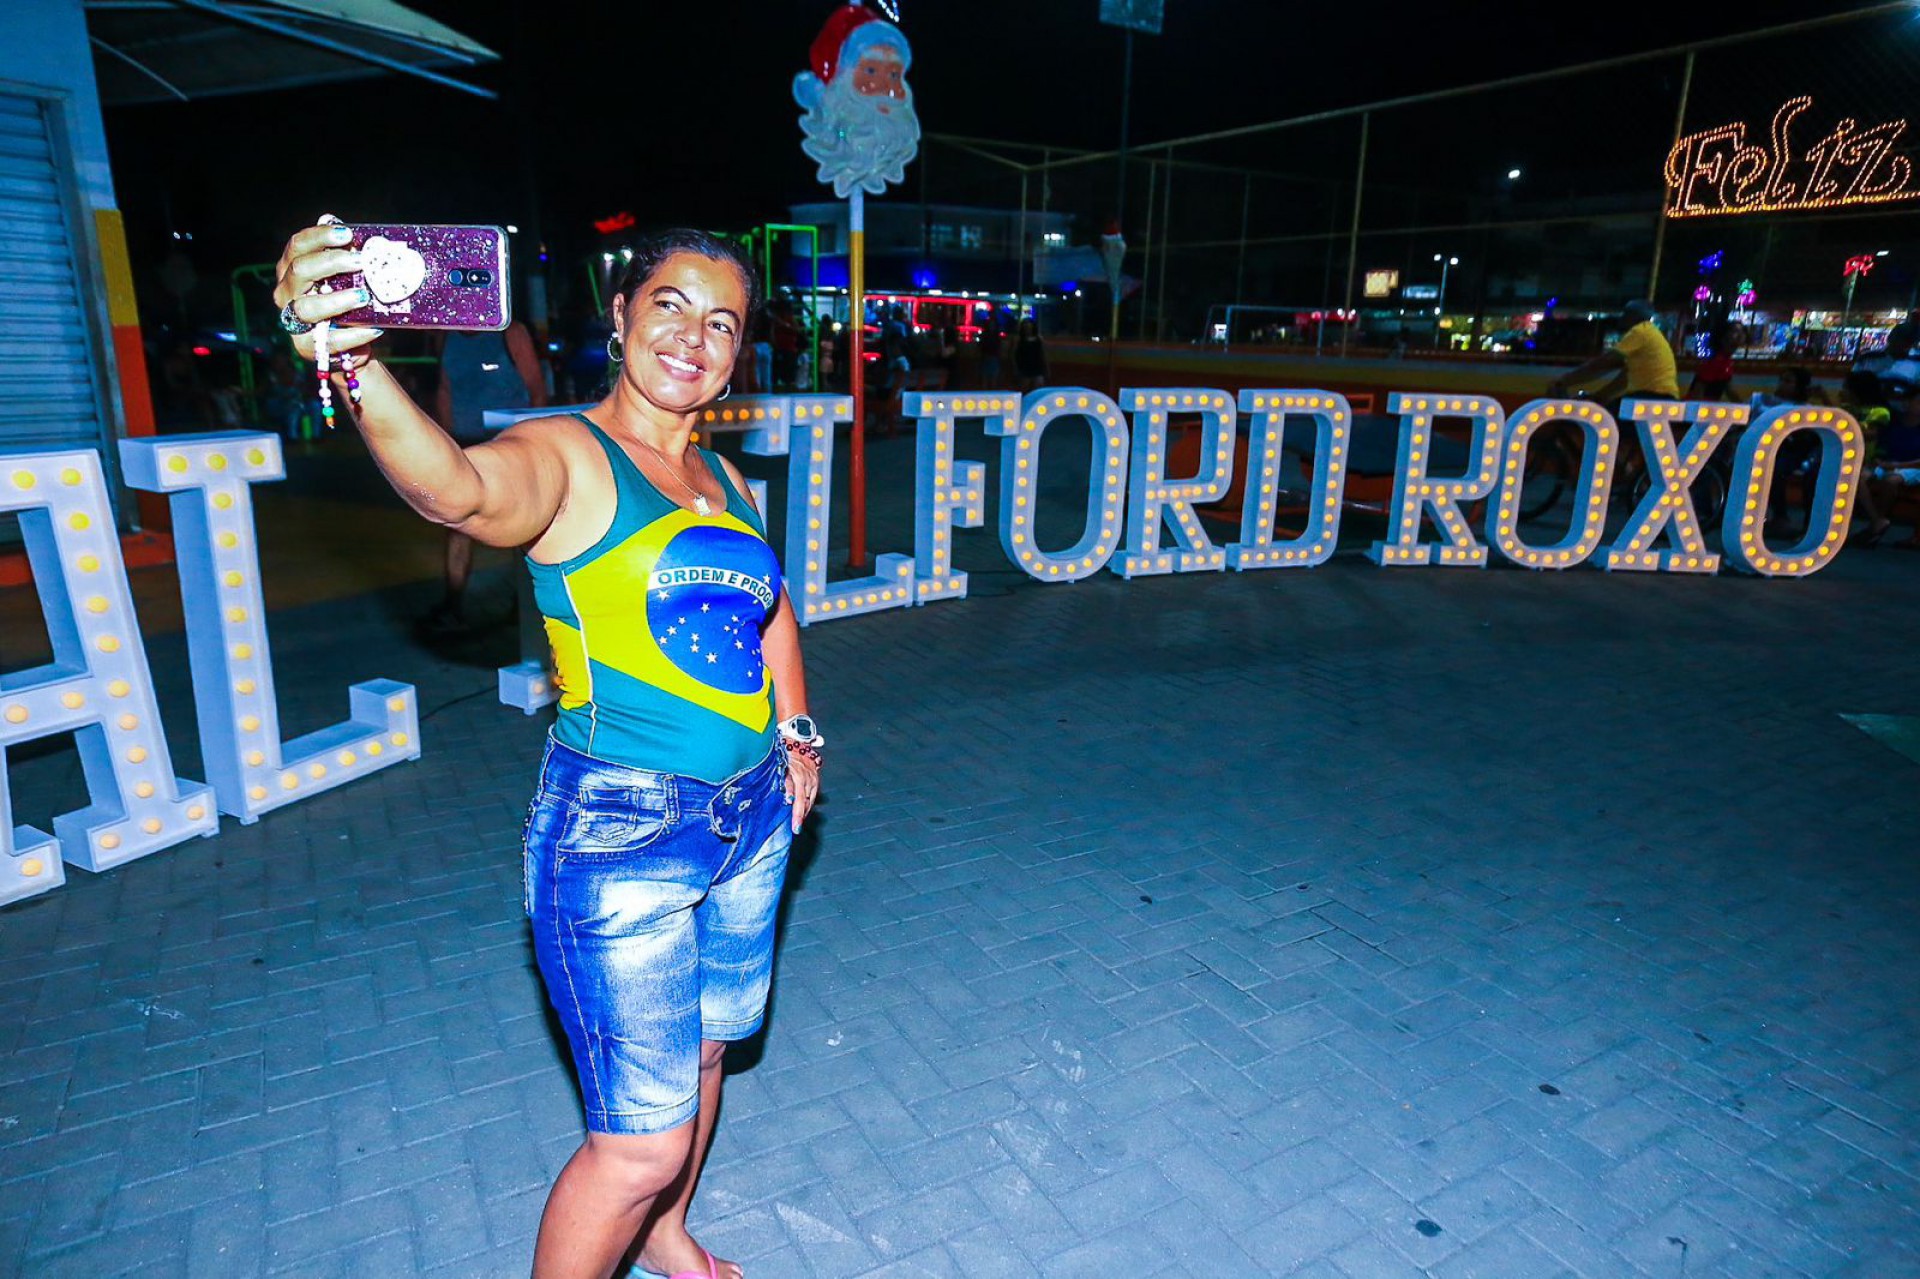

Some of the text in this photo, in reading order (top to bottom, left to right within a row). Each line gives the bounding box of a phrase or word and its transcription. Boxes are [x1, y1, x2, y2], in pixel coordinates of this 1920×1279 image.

[1364, 391, 1865, 577] ROXO
[657, 569, 725, 585] ORDEM
[728, 573, 739, 584] E
